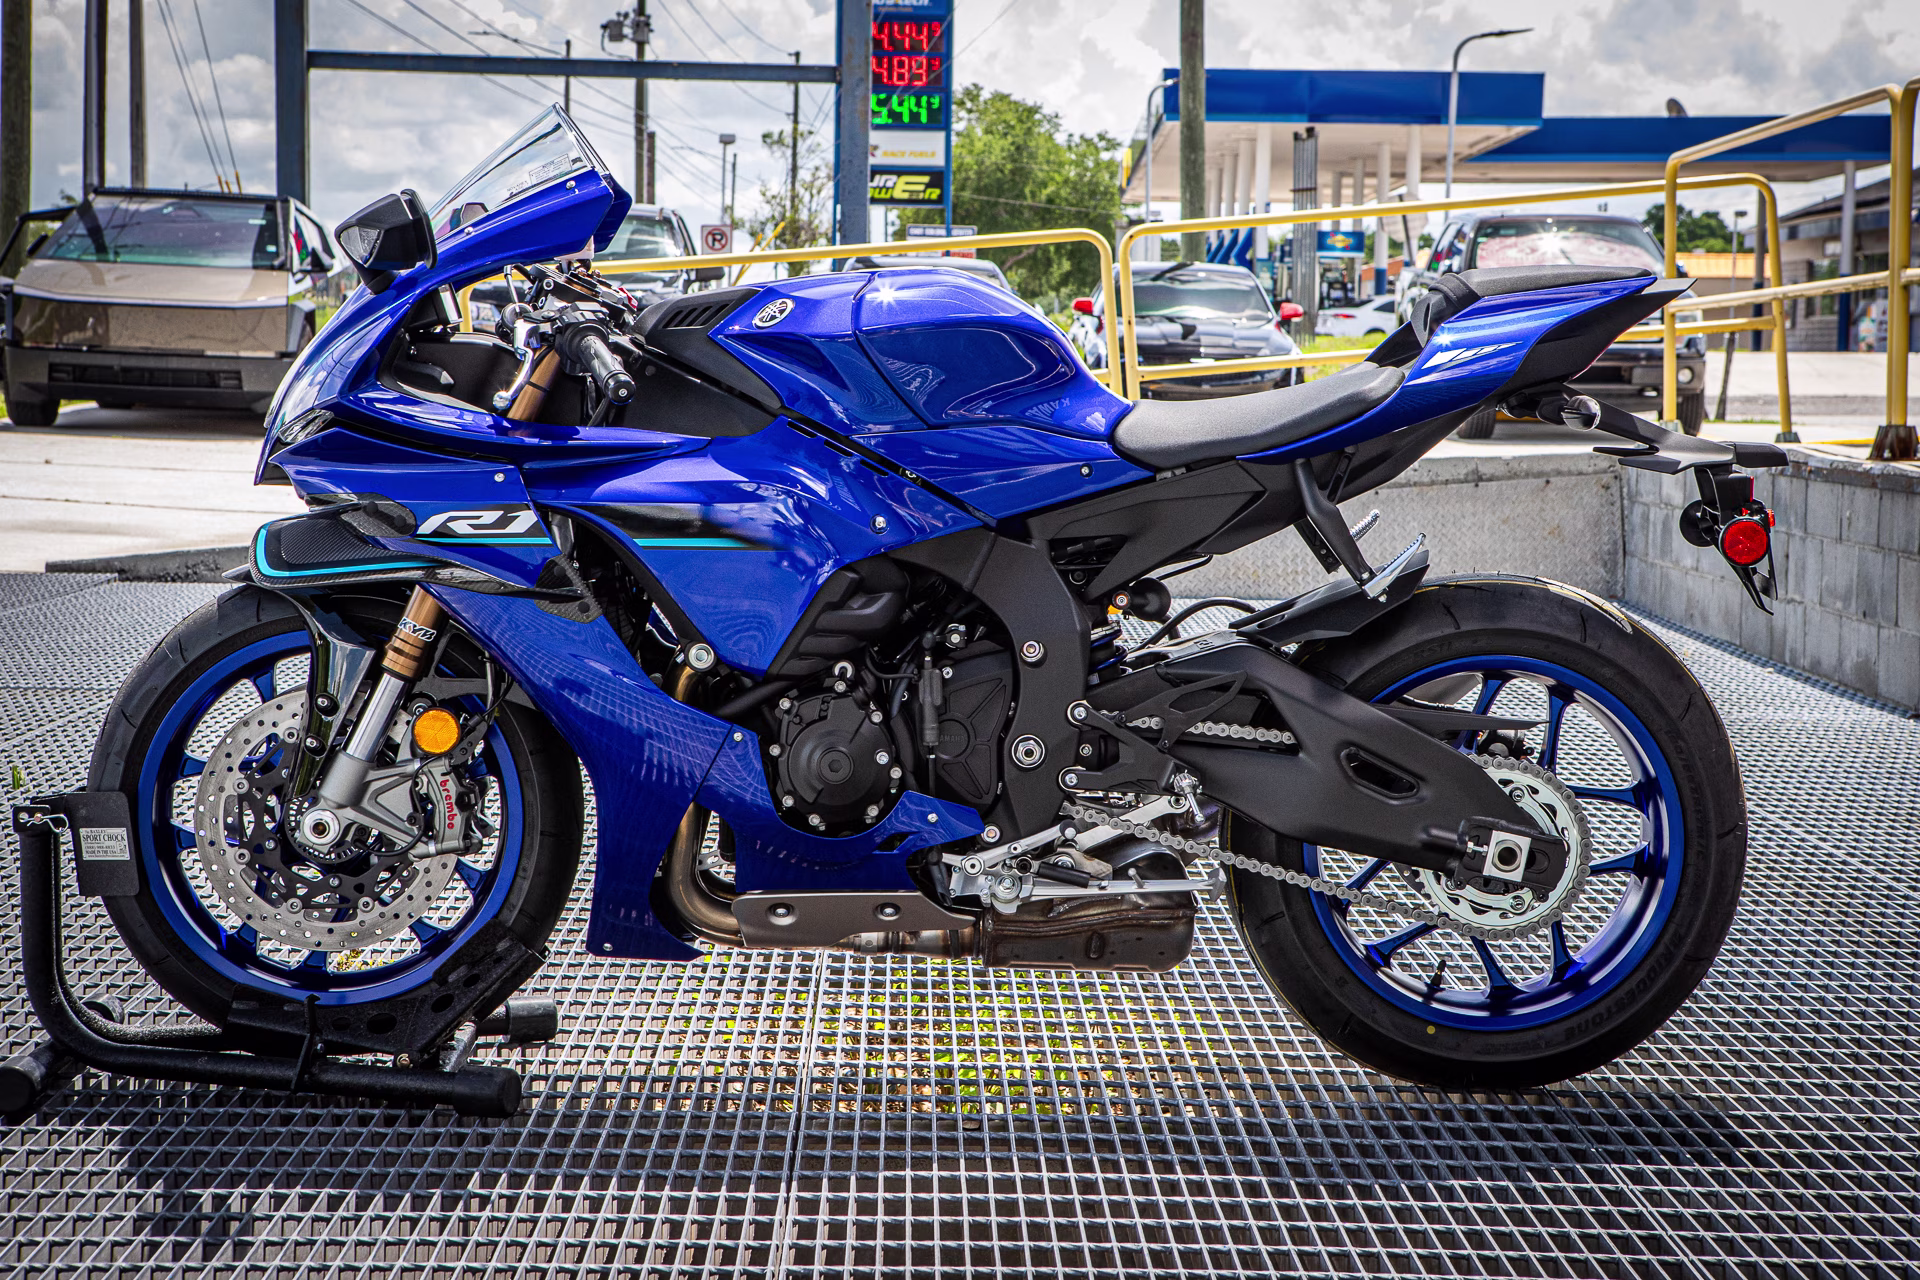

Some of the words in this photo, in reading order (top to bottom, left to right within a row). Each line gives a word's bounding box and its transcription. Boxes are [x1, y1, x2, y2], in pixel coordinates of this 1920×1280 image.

[416, 510, 538, 534] R1
[397, 616, 437, 642] KYB
[440, 779, 458, 830] brembo
[82, 834, 102, 842] SPORT
[103, 834, 126, 842] CHOCK
